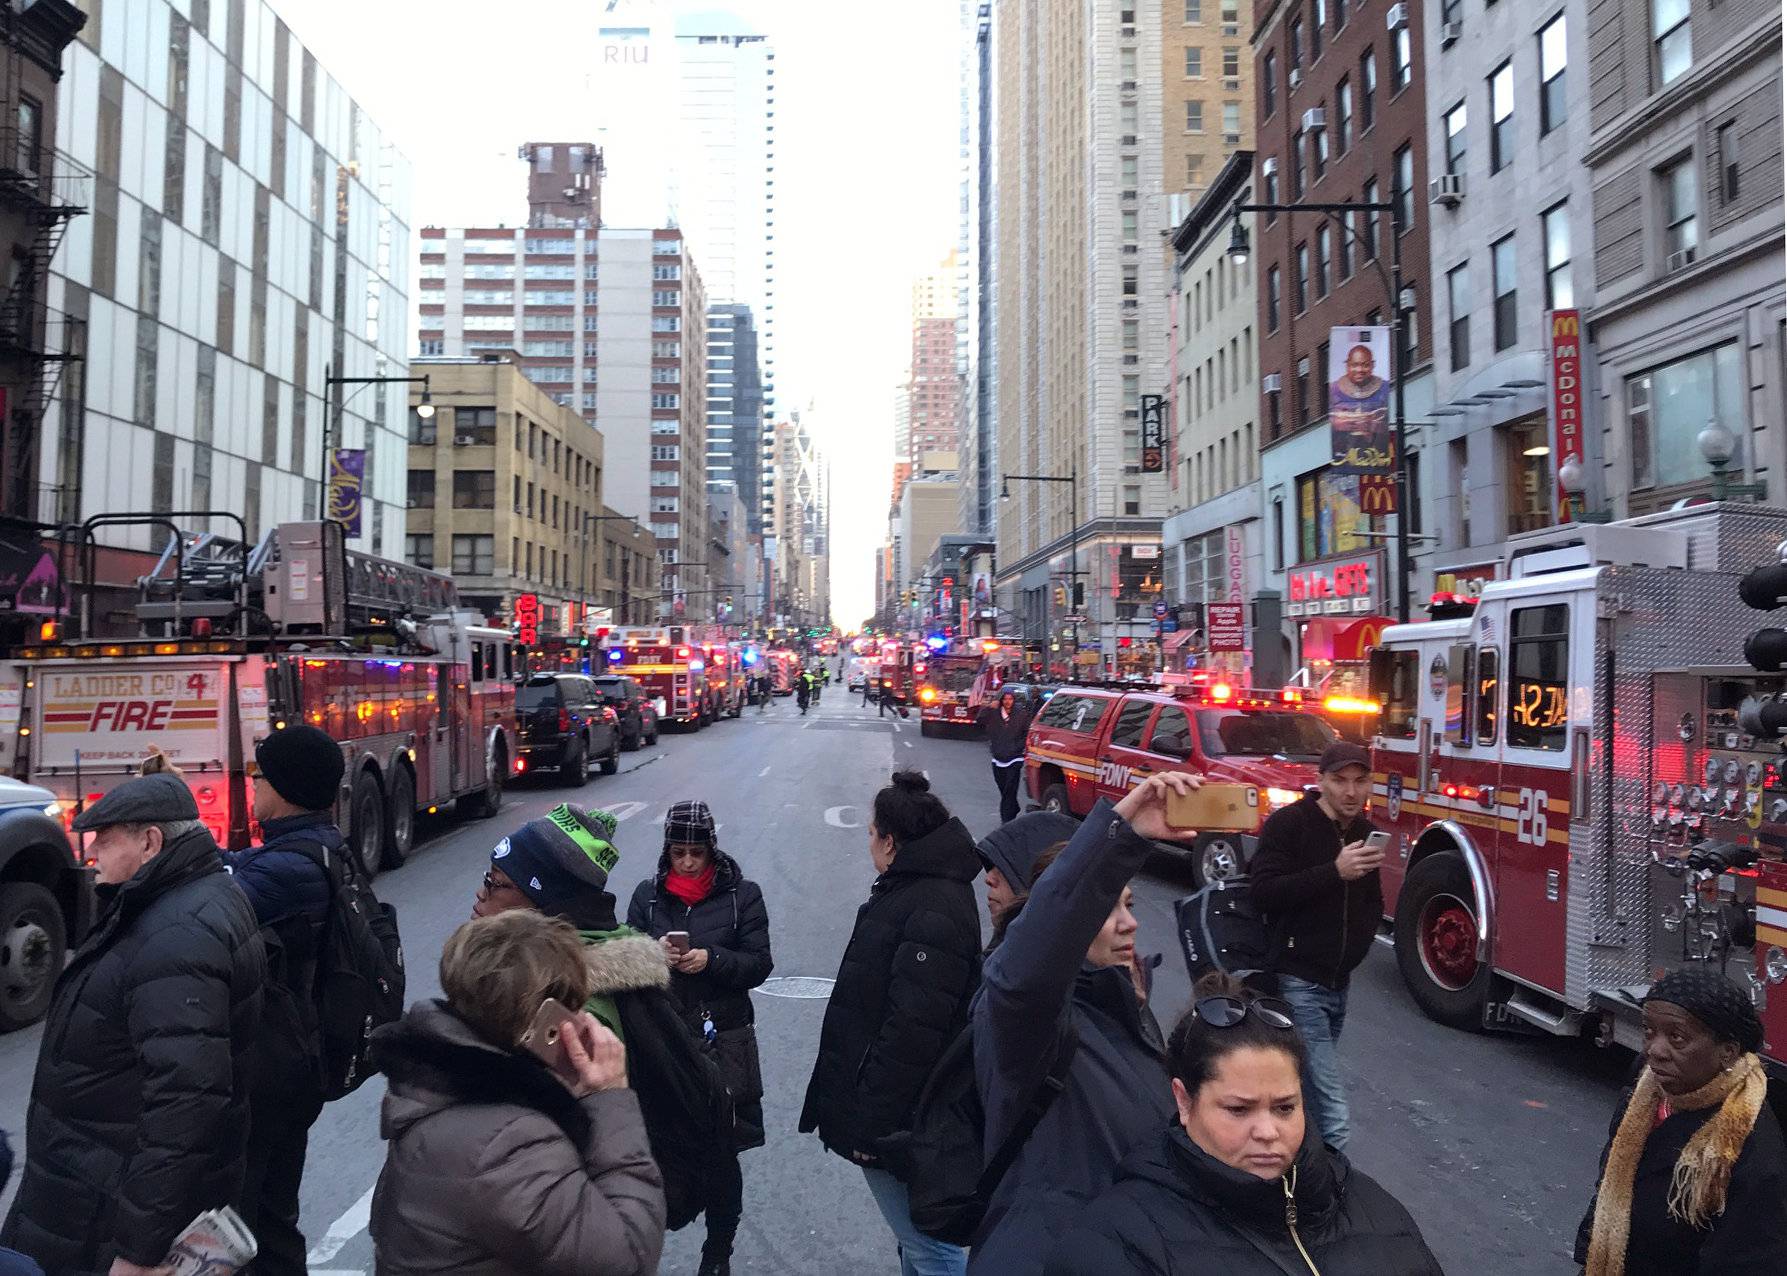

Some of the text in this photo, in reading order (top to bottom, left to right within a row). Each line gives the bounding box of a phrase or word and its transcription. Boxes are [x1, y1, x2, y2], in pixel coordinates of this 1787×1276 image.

[604, 45, 649, 65] RIU
[1144, 397, 1160, 448] PARK
[1228, 527, 1242, 604] LUGGAG
[519, 593, 537, 646] BAR
[1211, 638, 1242, 646] PHOTO
[53, 674, 144, 698] LADDER
[90, 700, 173, 732] FIRE
[1099, 761, 1133, 789] FDNY
[1518, 786, 1549, 848] 26
[1485, 1001, 1522, 1024] FD
